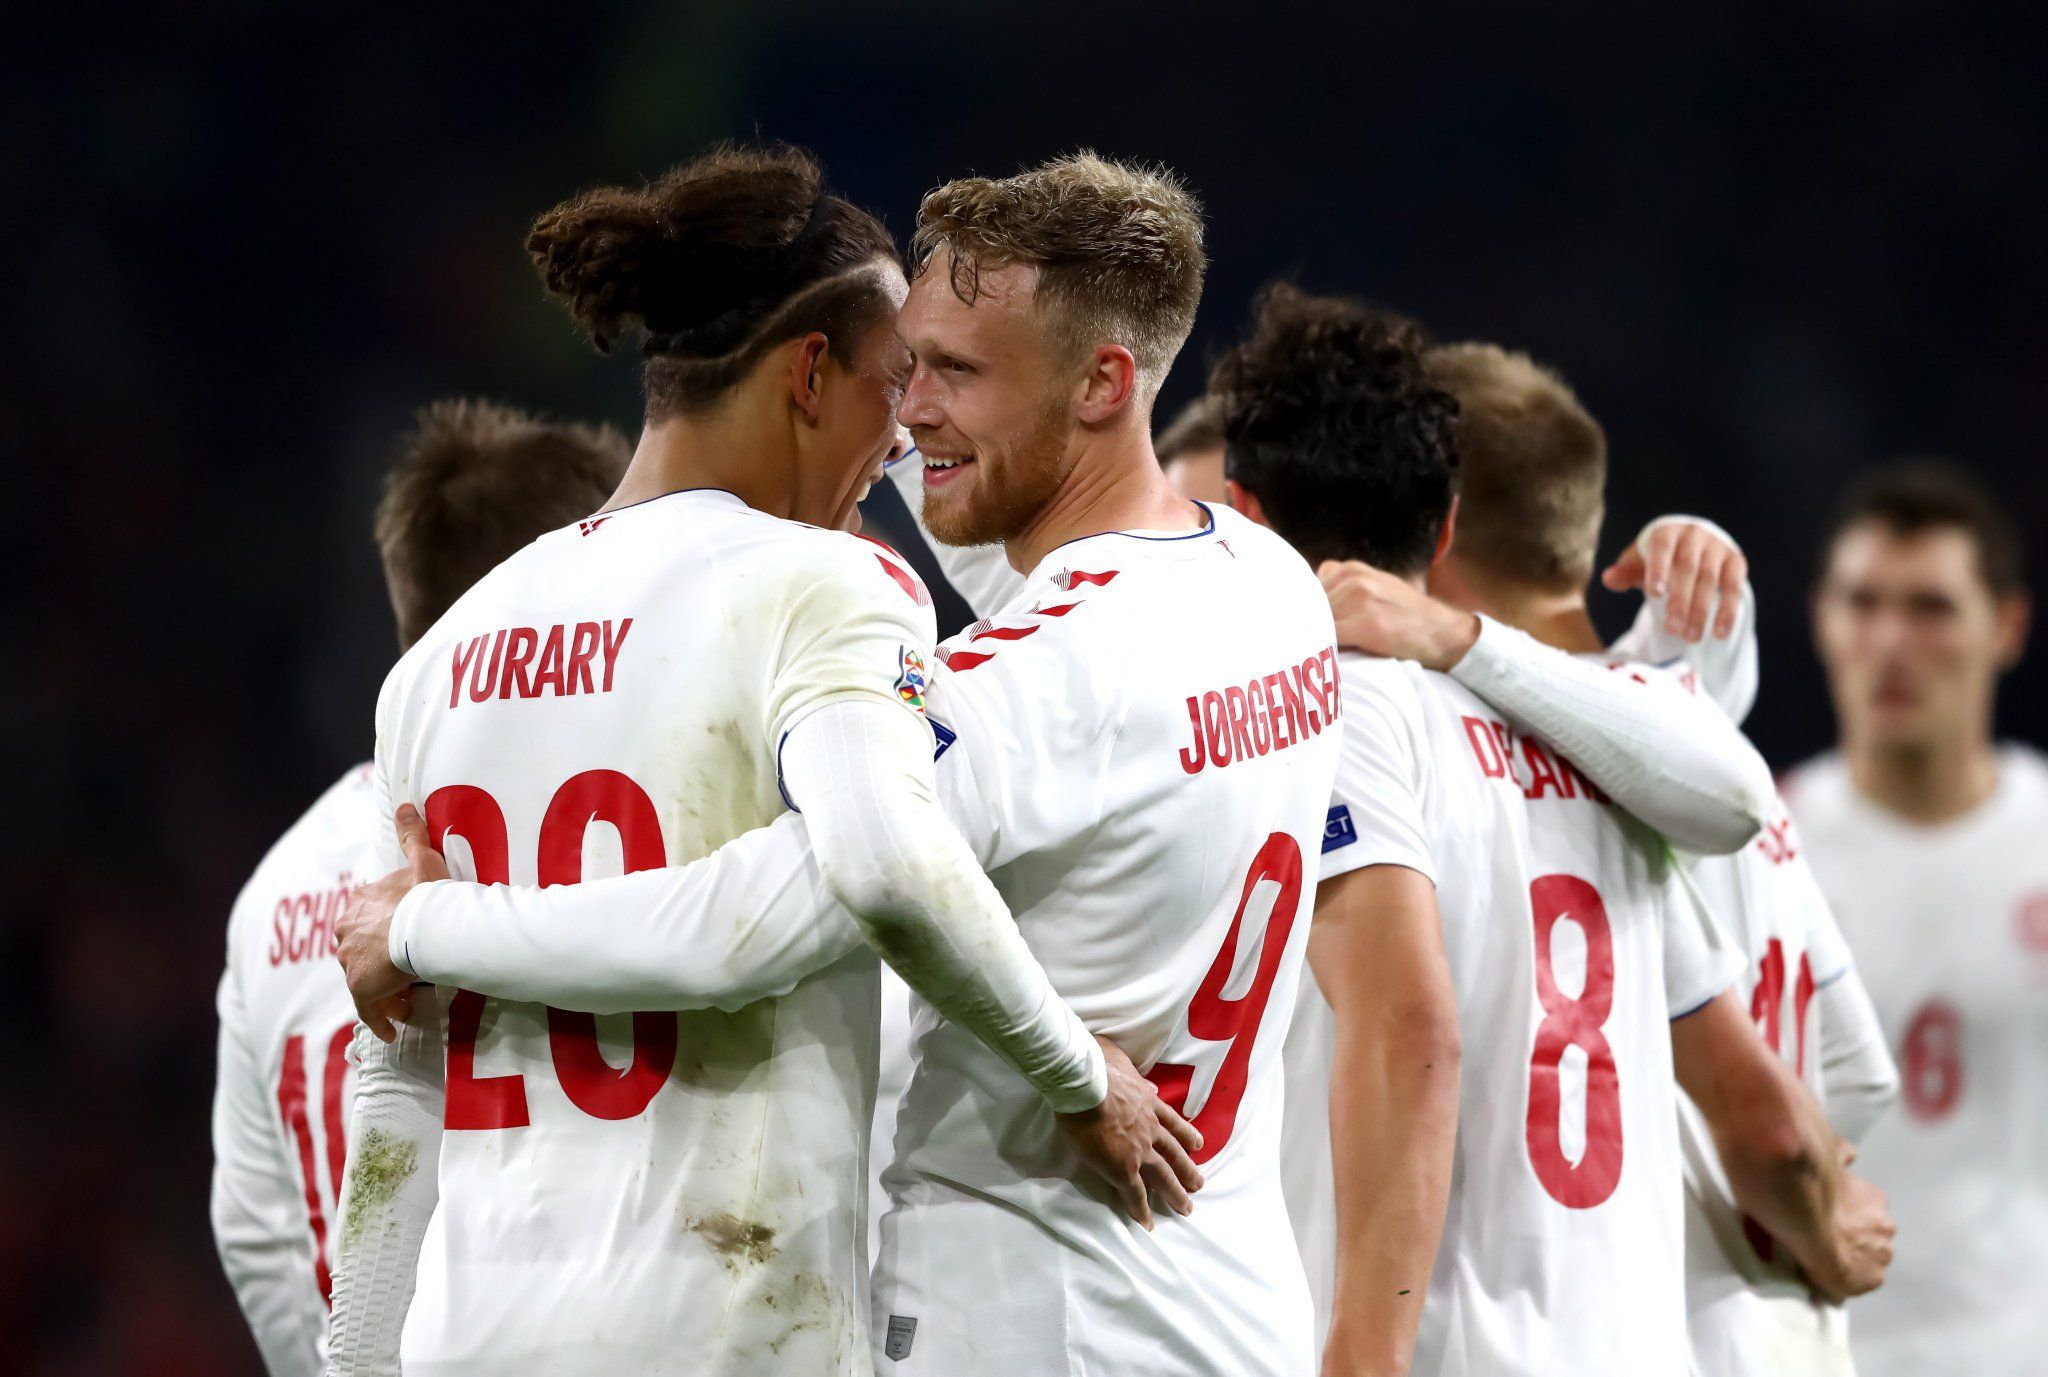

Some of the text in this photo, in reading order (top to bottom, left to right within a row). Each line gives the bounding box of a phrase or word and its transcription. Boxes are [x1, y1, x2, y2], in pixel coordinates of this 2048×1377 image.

[449, 618, 634, 709] YURARY
[269, 870, 352, 967] SCHÖ
[425, 769, 678, 1130] 20
[1144, 832, 1303, 1166] 9
[1525, 873, 1623, 1209] 8
[1900, 996, 1962, 1130] 6
